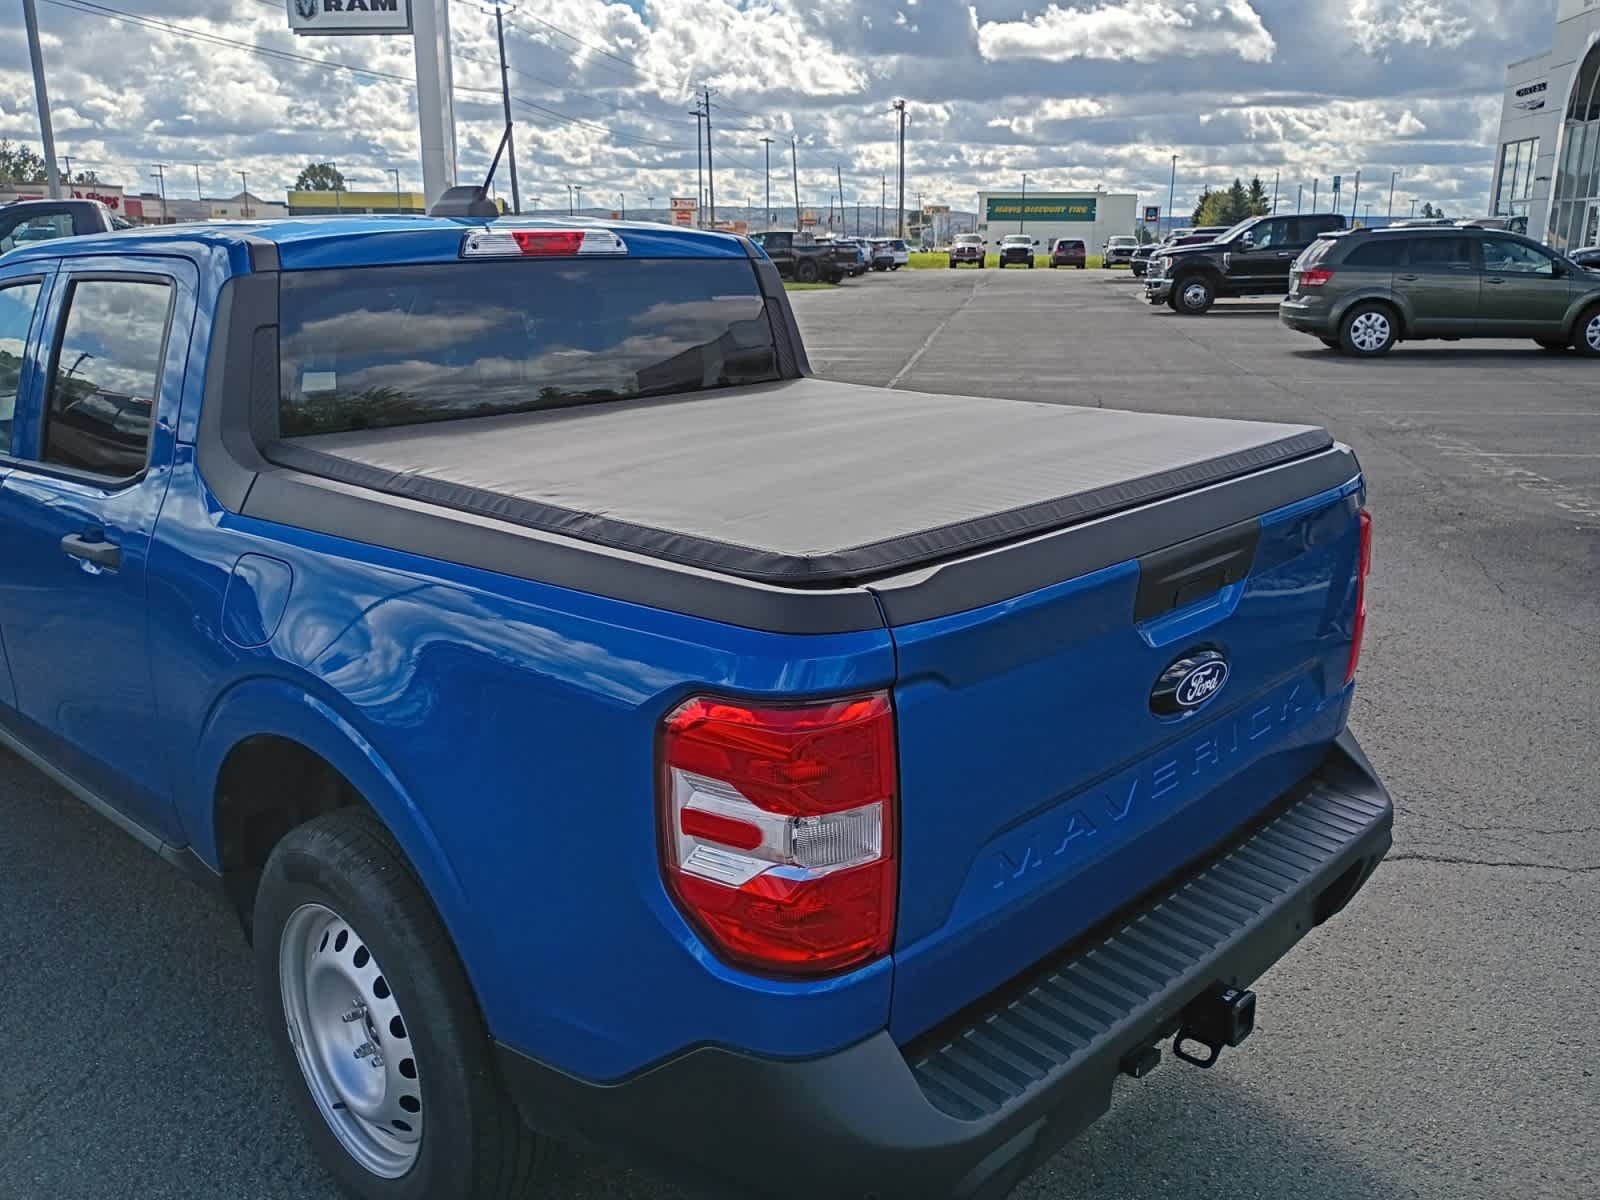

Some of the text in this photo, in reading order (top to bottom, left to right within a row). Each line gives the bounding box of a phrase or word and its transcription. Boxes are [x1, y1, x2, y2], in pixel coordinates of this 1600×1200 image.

[324, 0, 398, 12] RAM
[994, 206, 1089, 214] MAVIS DISCOUNT TIRE
[1187, 667, 1219, 701] Ford
[993, 684, 1303, 889] MAVERICK
